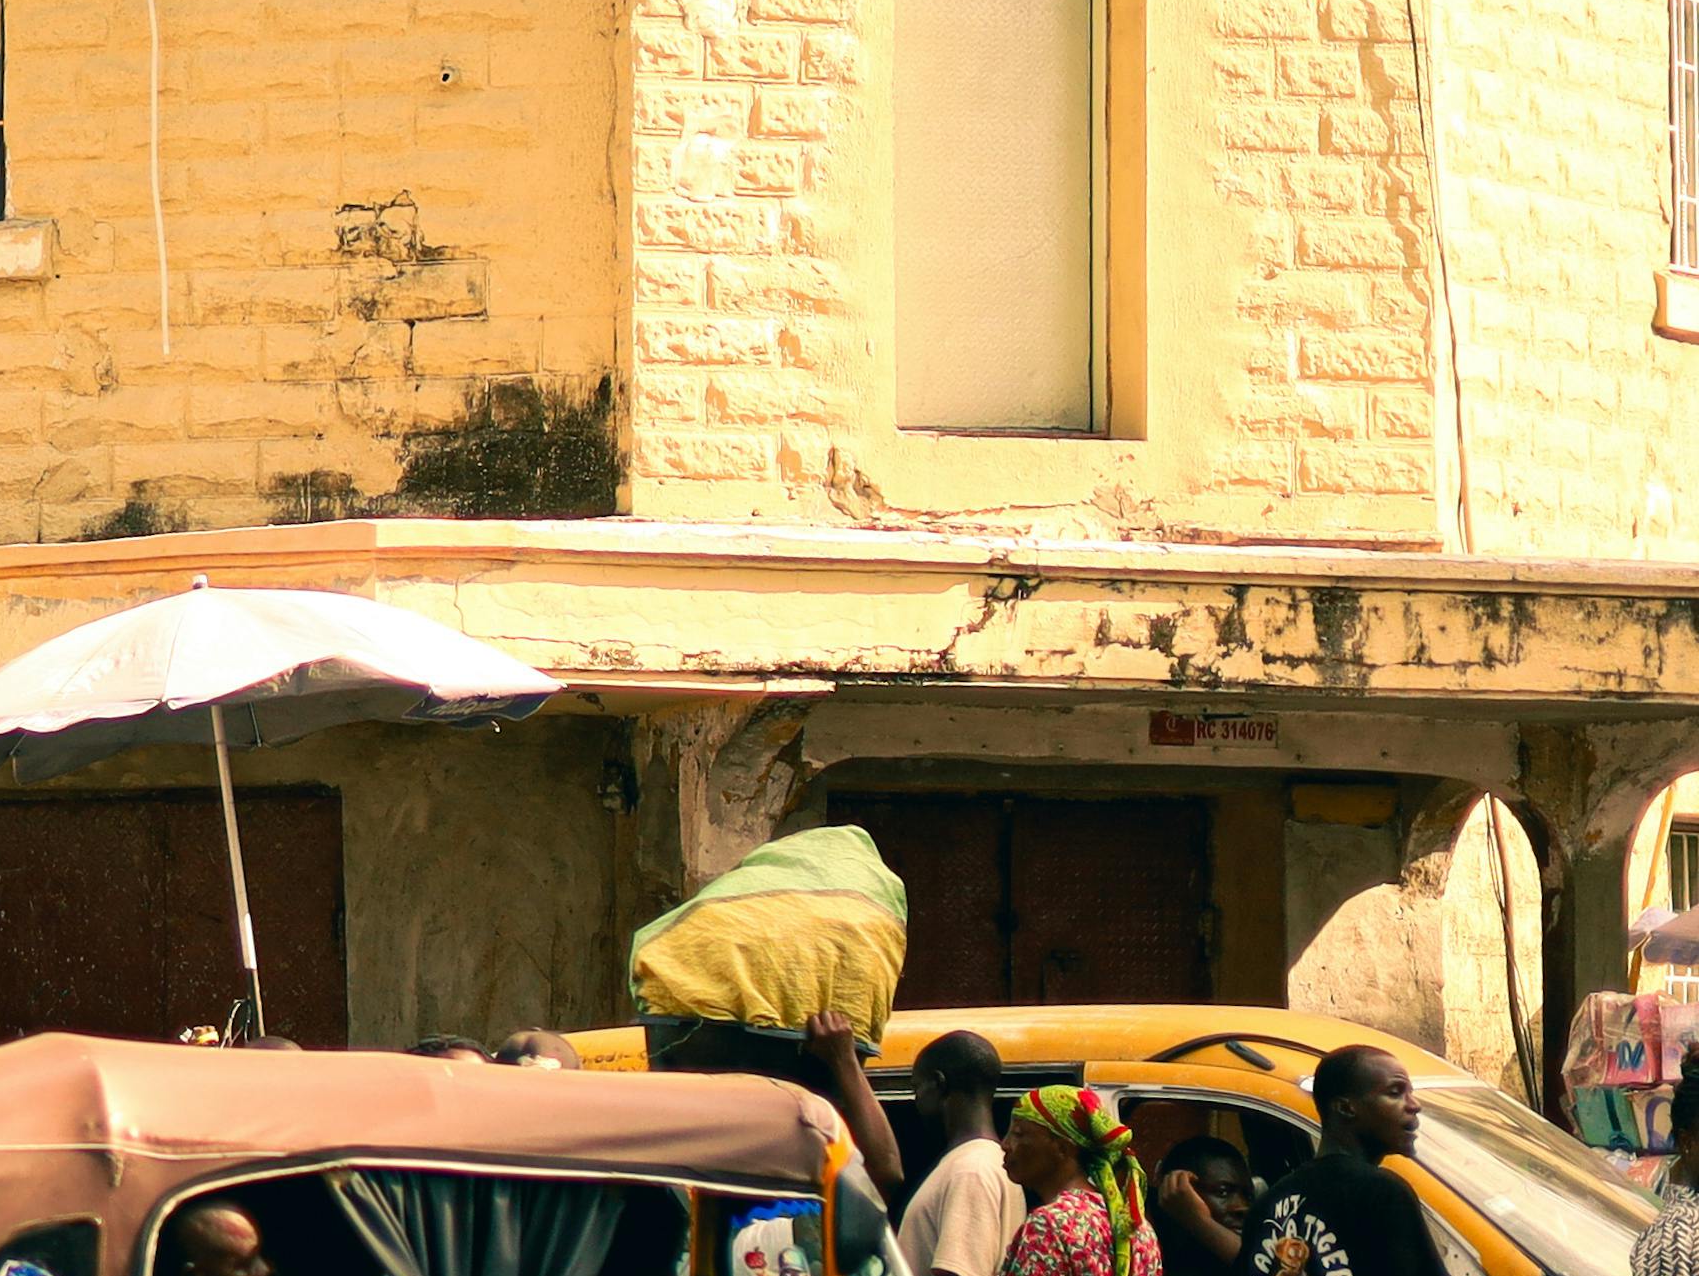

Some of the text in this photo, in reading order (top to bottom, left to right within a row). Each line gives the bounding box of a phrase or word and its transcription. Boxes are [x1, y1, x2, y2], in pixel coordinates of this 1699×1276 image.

[1196, 717, 1273, 741] RC 314076
[1275, 1194, 1301, 1219] NOT
[1286, 1218, 1298, 1238] A
